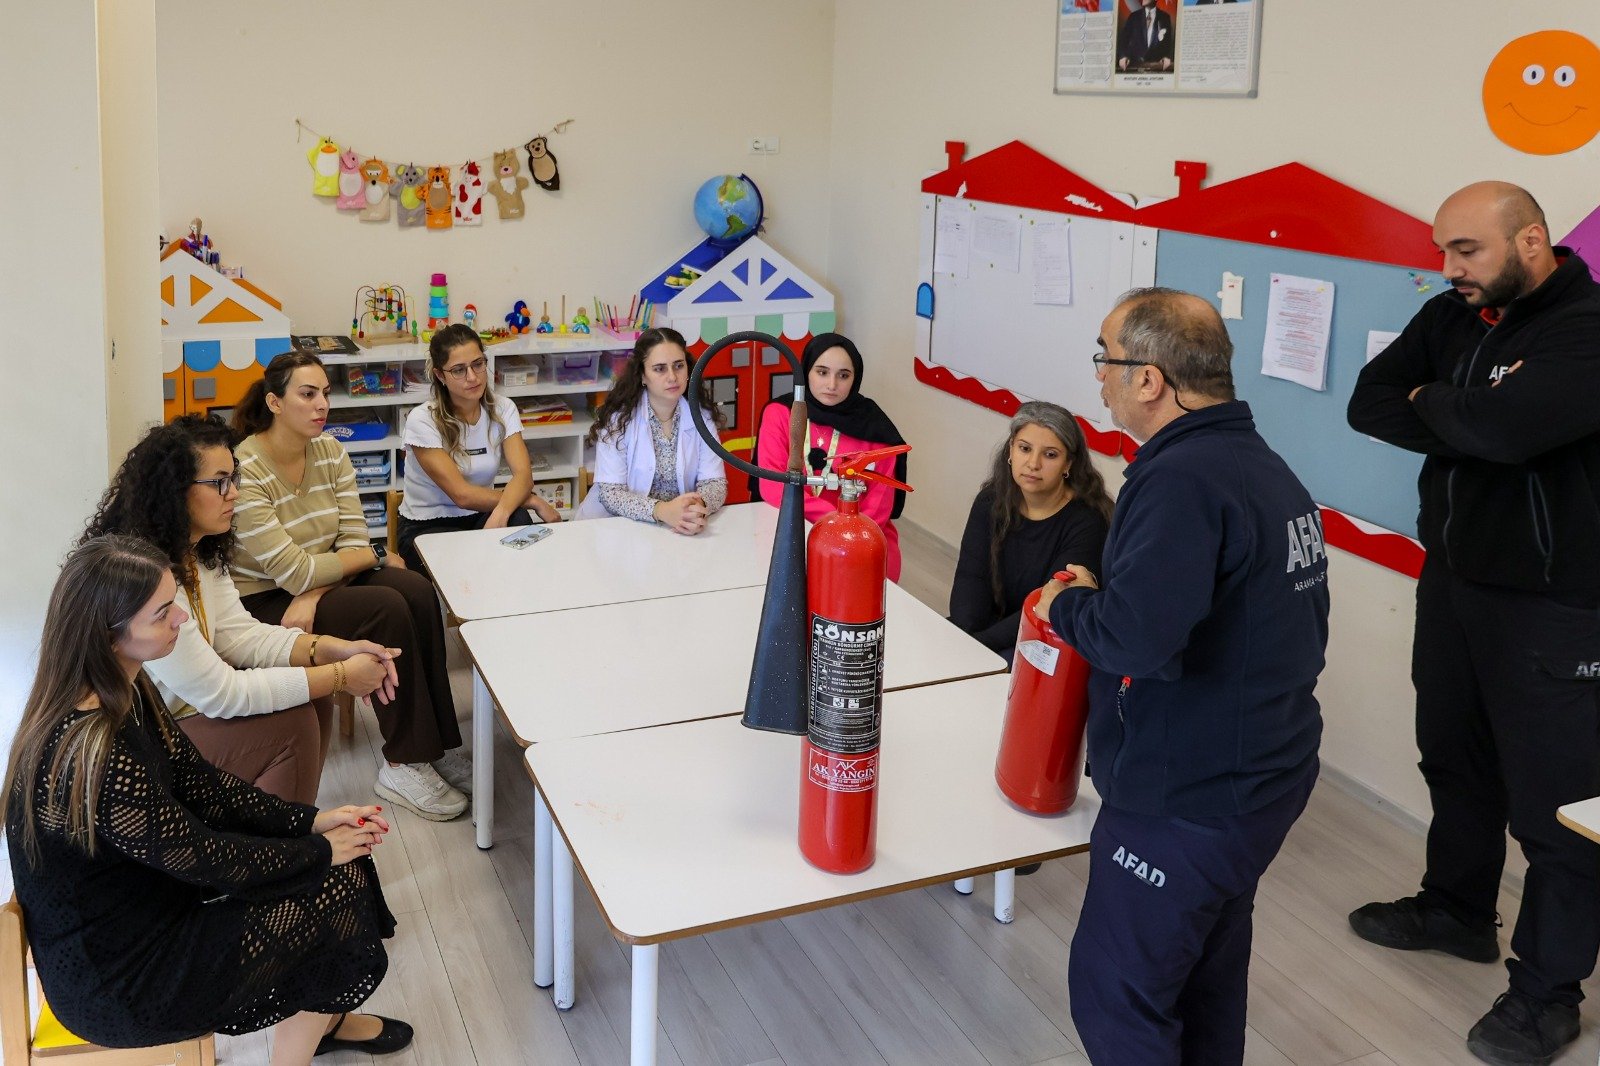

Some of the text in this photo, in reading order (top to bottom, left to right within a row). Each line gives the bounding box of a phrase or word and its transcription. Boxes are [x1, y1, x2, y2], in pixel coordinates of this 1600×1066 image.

[1489, 365, 1508, 380] AF
[812, 763, 830, 775] AK
[833, 767, 876, 779] YANGIN
[1112, 845, 1166, 888] AFAD
